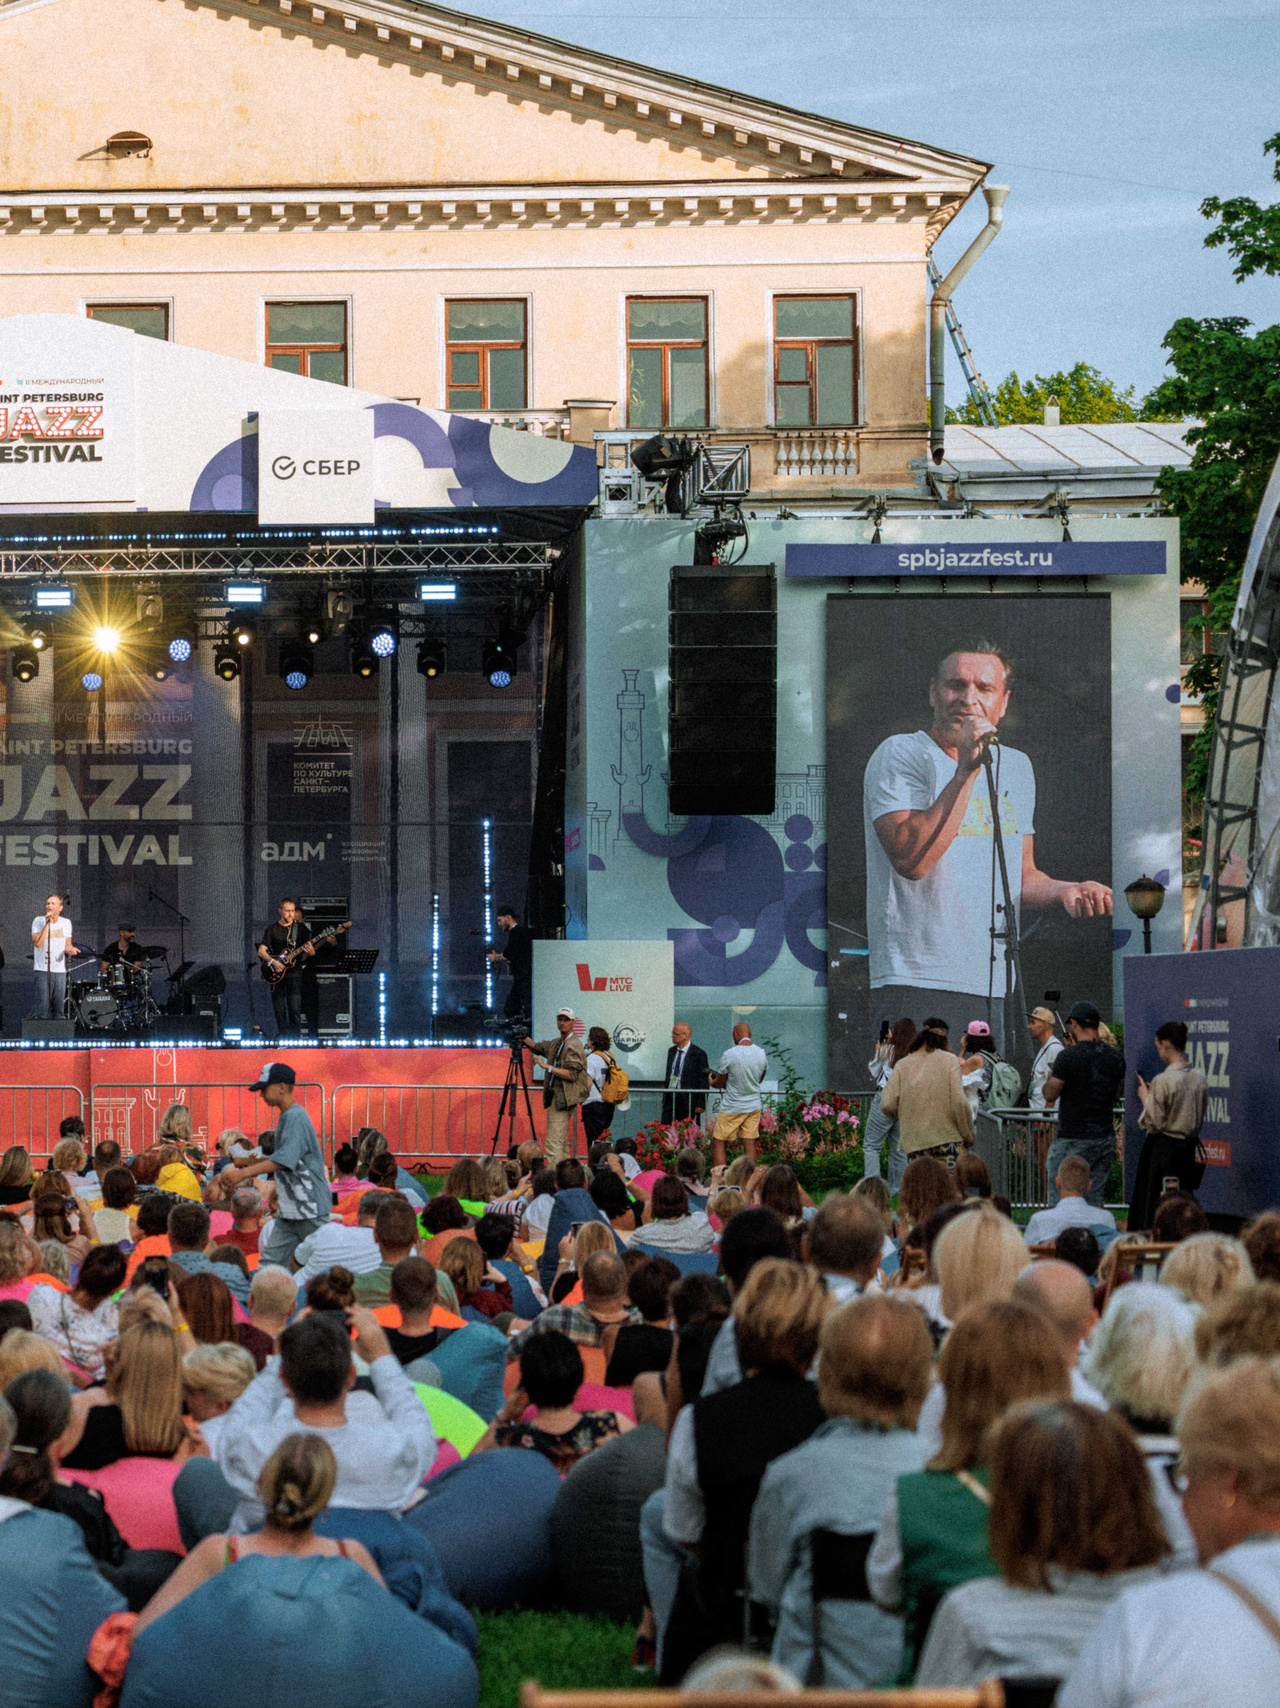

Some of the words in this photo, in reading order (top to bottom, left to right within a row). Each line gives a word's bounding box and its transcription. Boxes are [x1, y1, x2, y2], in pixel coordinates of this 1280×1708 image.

[31, 378, 105, 386] МЕЖДУНАРОДНЫЙ
[23, 392, 105, 403] PETERSBURG
[302, 459, 361, 476] СБЕР
[897, 548, 1053, 571] spbjazzfest.ru
[50, 738, 193, 756] PETERSBURG
[293, 769, 307, 777] ПО
[308, 769, 353, 777] КУЛЬТУРЕ
[293, 785, 349, 793] ПЕТЕРБУРГА
